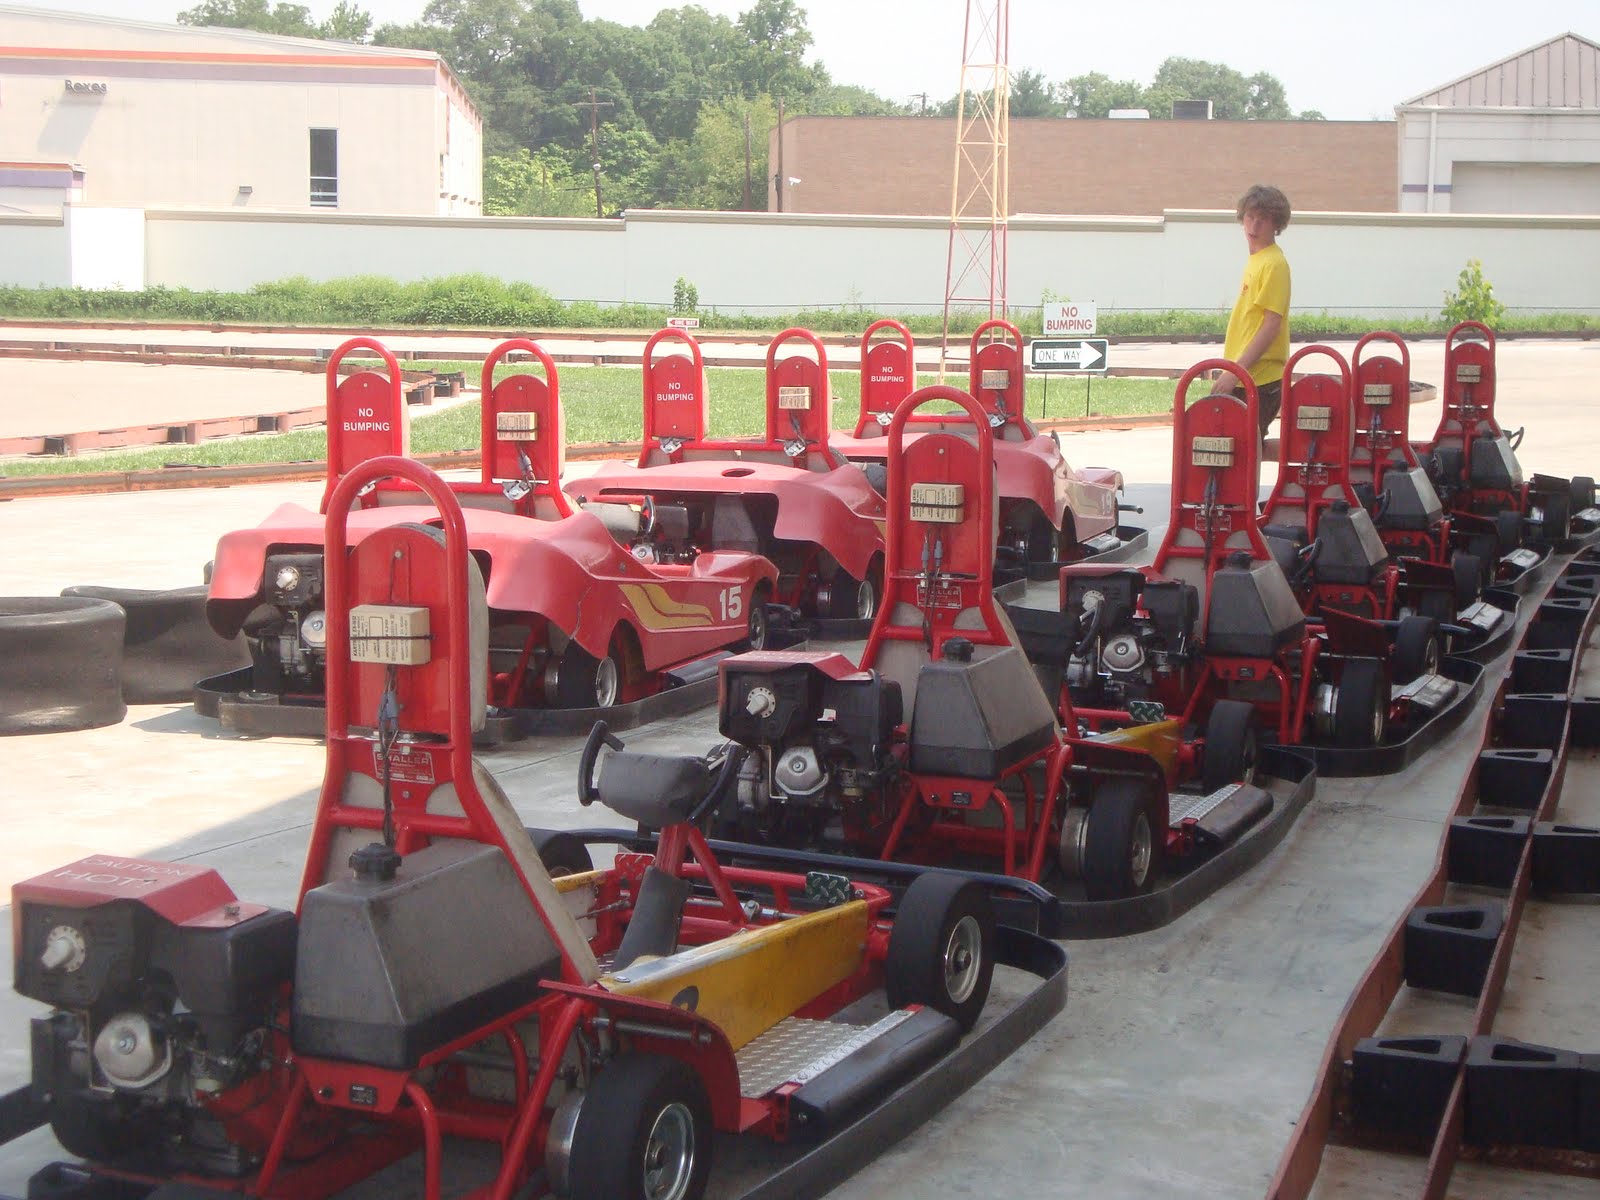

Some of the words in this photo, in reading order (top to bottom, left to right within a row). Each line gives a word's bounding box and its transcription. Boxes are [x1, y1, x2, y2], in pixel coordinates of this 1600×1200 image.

[1061, 307, 1078, 317] NO
[1046, 319, 1093, 330] BUMPING
[1038, 350, 1057, 361] ONE
[1063, 350, 1081, 361] WAY
[668, 382, 681, 390] NO
[656, 393, 694, 401] BUMPING
[358, 408, 374, 417] NO
[343, 422, 390, 431] BUMPING
[719, 585, 742, 621] 15
[81, 858, 187, 876] CAUTION
